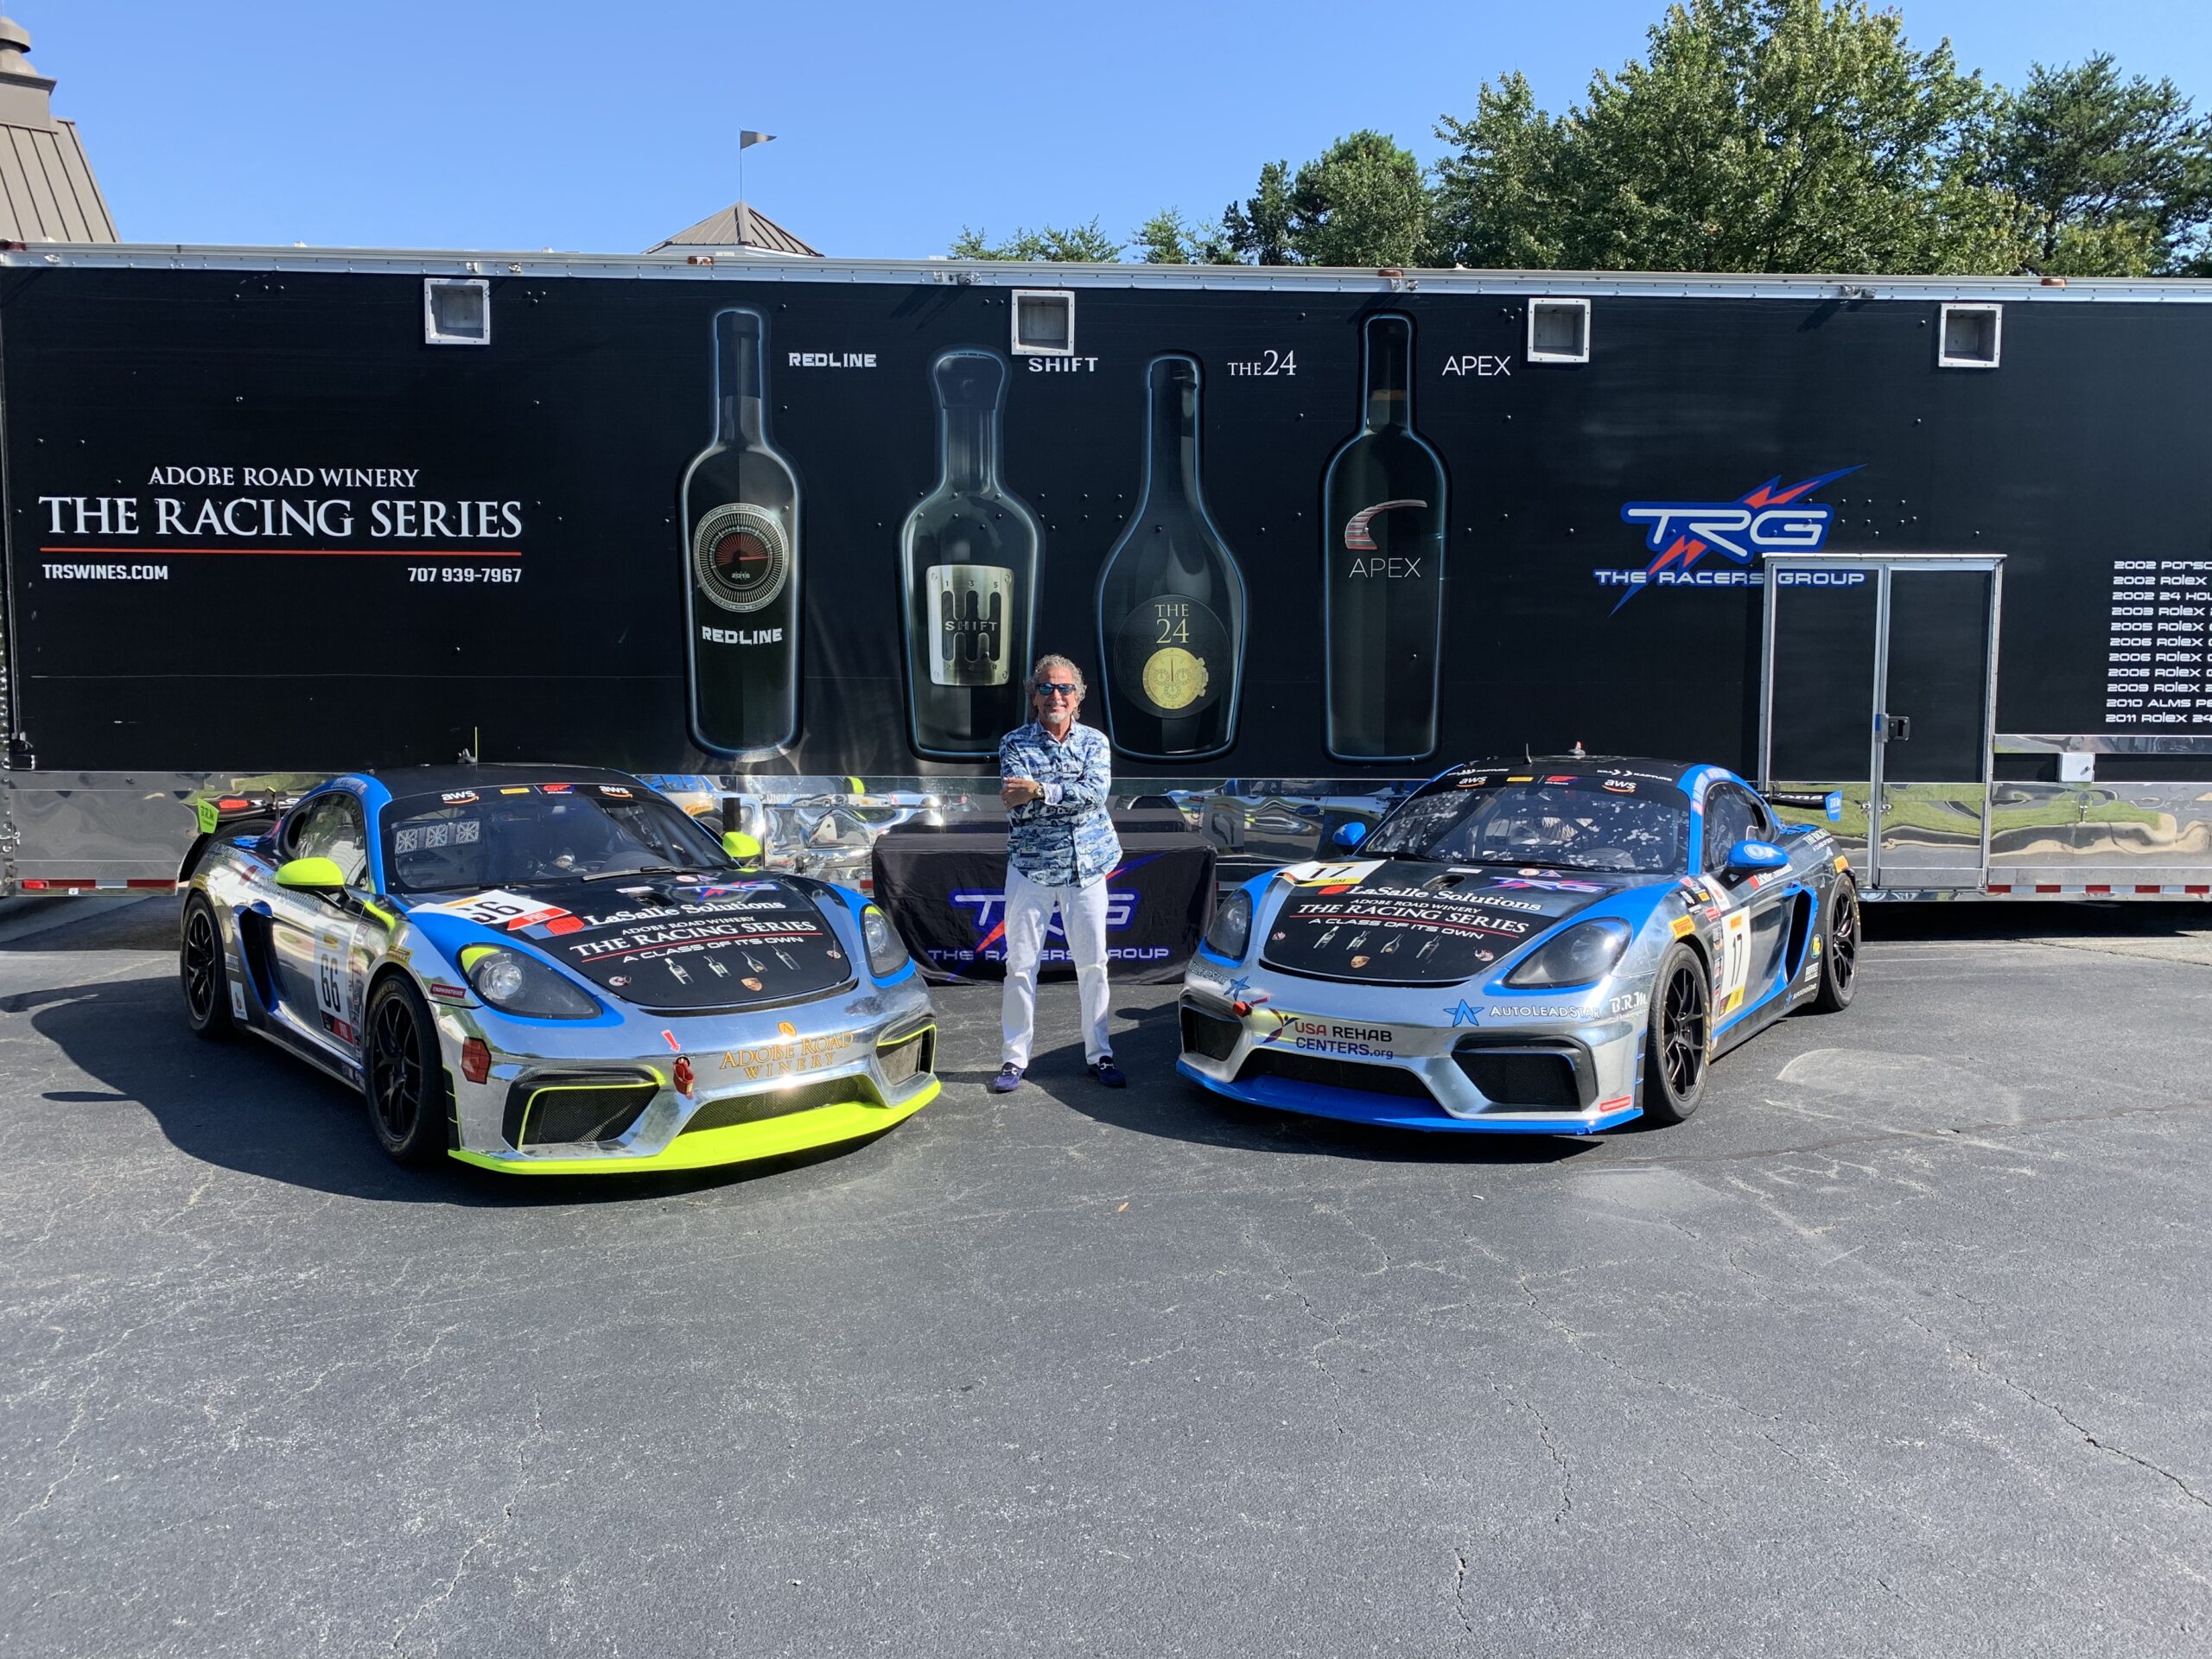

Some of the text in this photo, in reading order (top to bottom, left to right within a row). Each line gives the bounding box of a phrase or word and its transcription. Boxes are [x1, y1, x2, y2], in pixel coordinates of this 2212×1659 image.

[789, 353, 877, 368] REDLINE
[1028, 357, 1098, 372] SHIFT
[1441, 355, 1511, 376] APEX
[148, 467, 419, 487] ADOBE ROAD WINERY
[39, 496, 522, 538] THE RACING SERIES
[1627, 509, 1827, 557] TRG
[42, 564, 168, 580] TRSWINES.COM
[1349, 557, 1421, 578] APEX
[2113, 561, 2157, 569] 2002
[408, 567, 522, 583] 707 939-7967
[1595, 571, 1865, 585] THE RACERS GROUP
[2113, 576, 2156, 585] 2002
[2113, 592, 2155, 601] 2002
[2159, 592, 2181, 601] 24
[1154, 604, 1189, 617] THE
[2112, 607, 2154, 616] 2003
[944, 621, 997, 632] SHIFT
[1156, 618, 1189, 644] 24
[2111, 622, 2153, 632] 2005
[702, 626, 783, 645] REDLINE
[2110, 638, 2152, 646] 2006
[2109, 652, 2152, 662] 2006
[2108, 668, 2151, 677] 2006
[2107, 683, 2149, 692] 2009
[2107, 699, 2143, 708] 2010
[2147, 699, 2191, 708] ALMS
[2106, 714, 2137, 723] 2011
[1458, 776, 1488, 785] aws
[1605, 779, 1637, 790] aws
[441, 791, 476, 802] aws
[599, 785, 628, 795] aws
[1310, 867, 1354, 879] 17
[1346, 886, 1542, 912] LaSalle Solutions
[583, 900, 786, 926] LaSalle Solutions
[1432, 903, 1483, 914] WINERY
[621, 916, 755, 936] ADOBE ROAD WINERY
[1297, 904, 1530, 934] THE RACING SERIES
[569, 920, 817, 957] THE RACING SERIES
[1410, 922, 1440, 932] ITS
[1441, 927, 1485, 940] OWN
[623, 936, 804, 963] A CLASS OF ITS OWN
[928, 950, 974, 960] THE
[1107, 948, 1170, 960] ROUP
[321, 953, 341, 1013] 66
[1489, 1005, 1601, 1020] AUTOLEADSTAR
[1295, 1022, 1393, 1043] USA REHAB
[1296, 1037, 1394, 1060] CENTERS.org
[721, 1047, 796, 1071] ADOBE
[746, 1052, 836, 1081] WINERY
